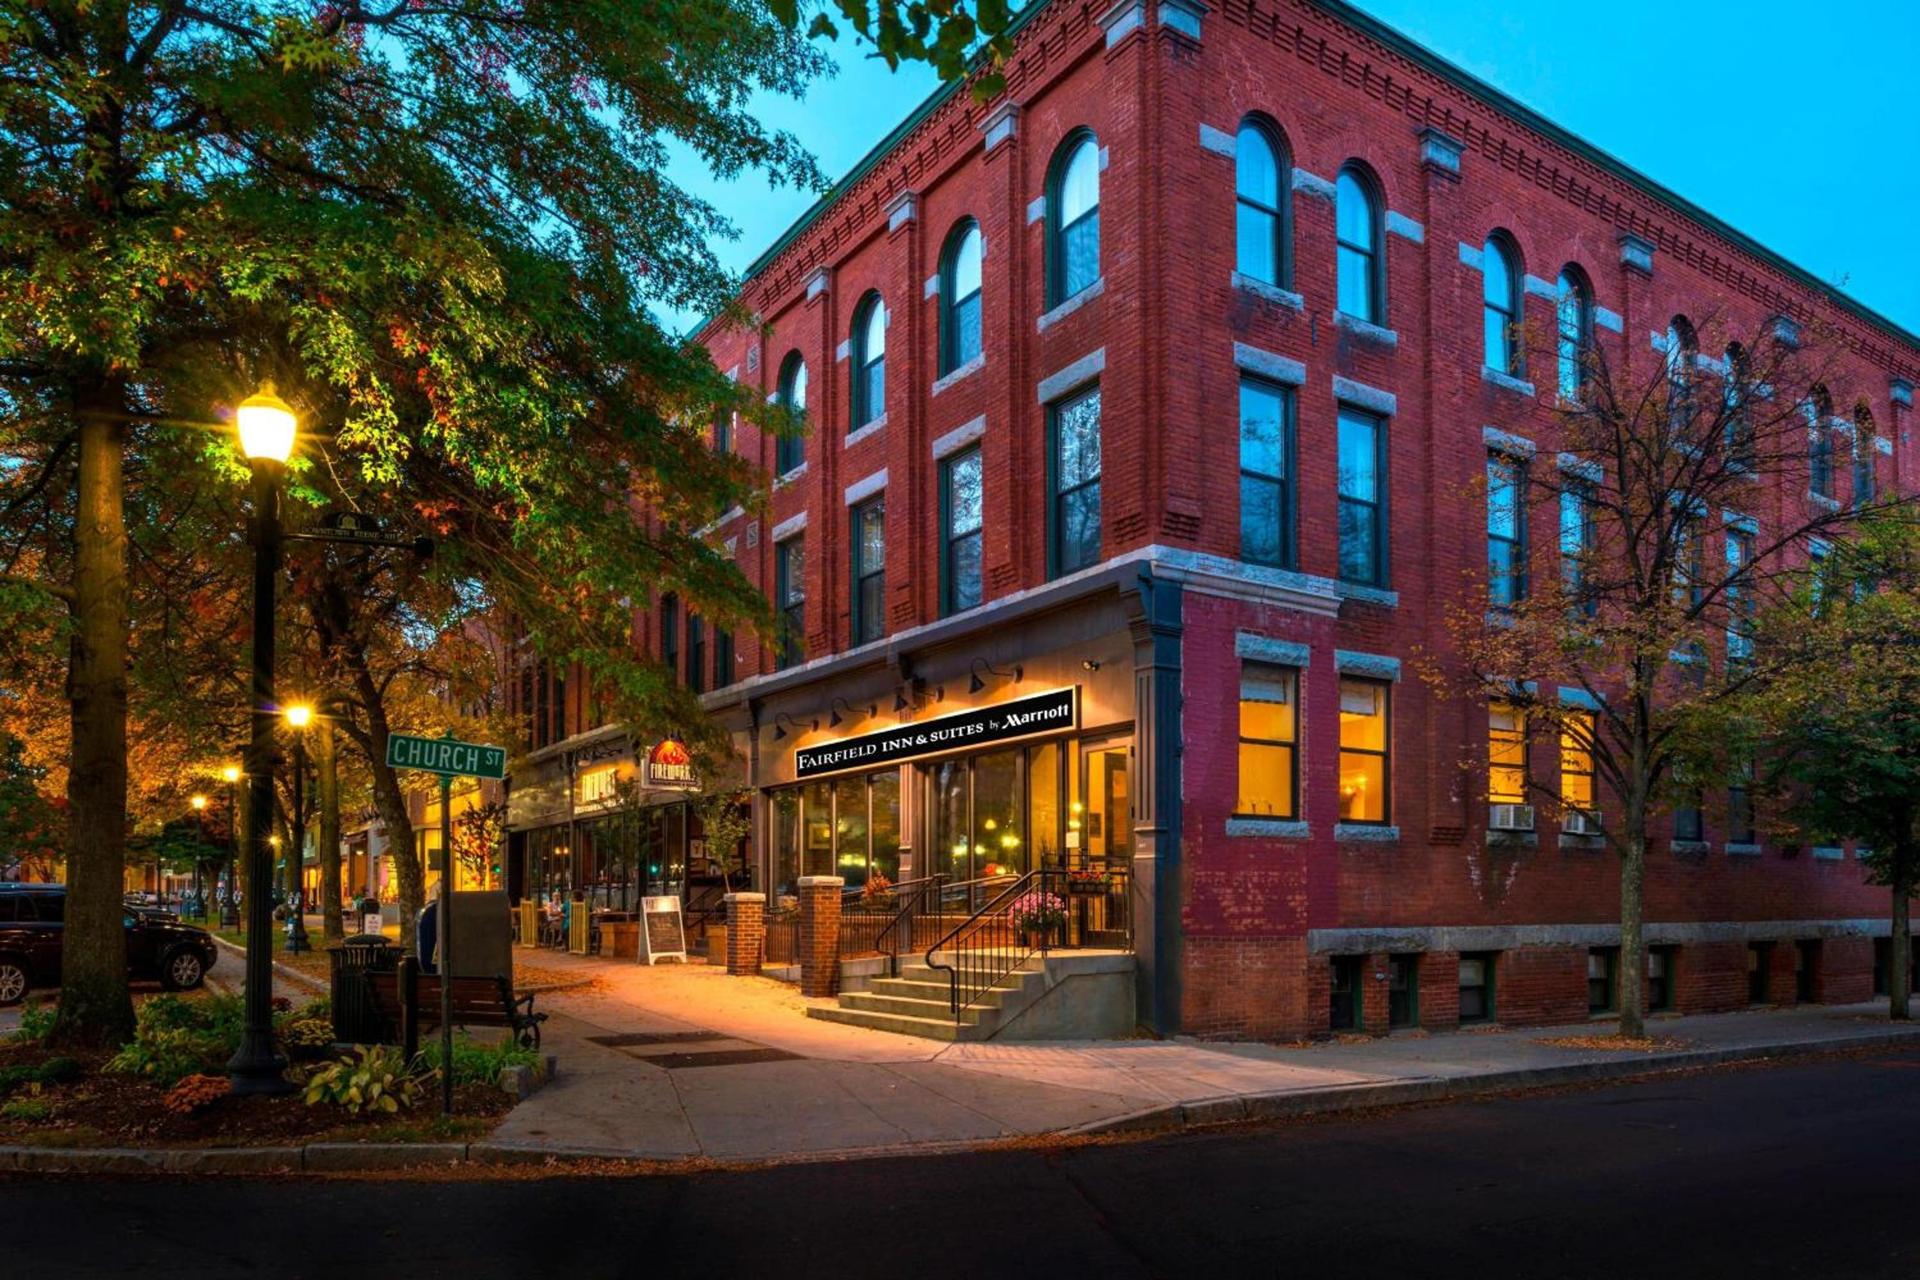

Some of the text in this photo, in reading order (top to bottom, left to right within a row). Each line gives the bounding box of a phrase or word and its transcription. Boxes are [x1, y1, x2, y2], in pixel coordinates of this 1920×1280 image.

[393, 738, 501, 772] CHURCH ST
[798, 704, 1069, 770] FAIRFIELD INN & SUITES by Marriott
